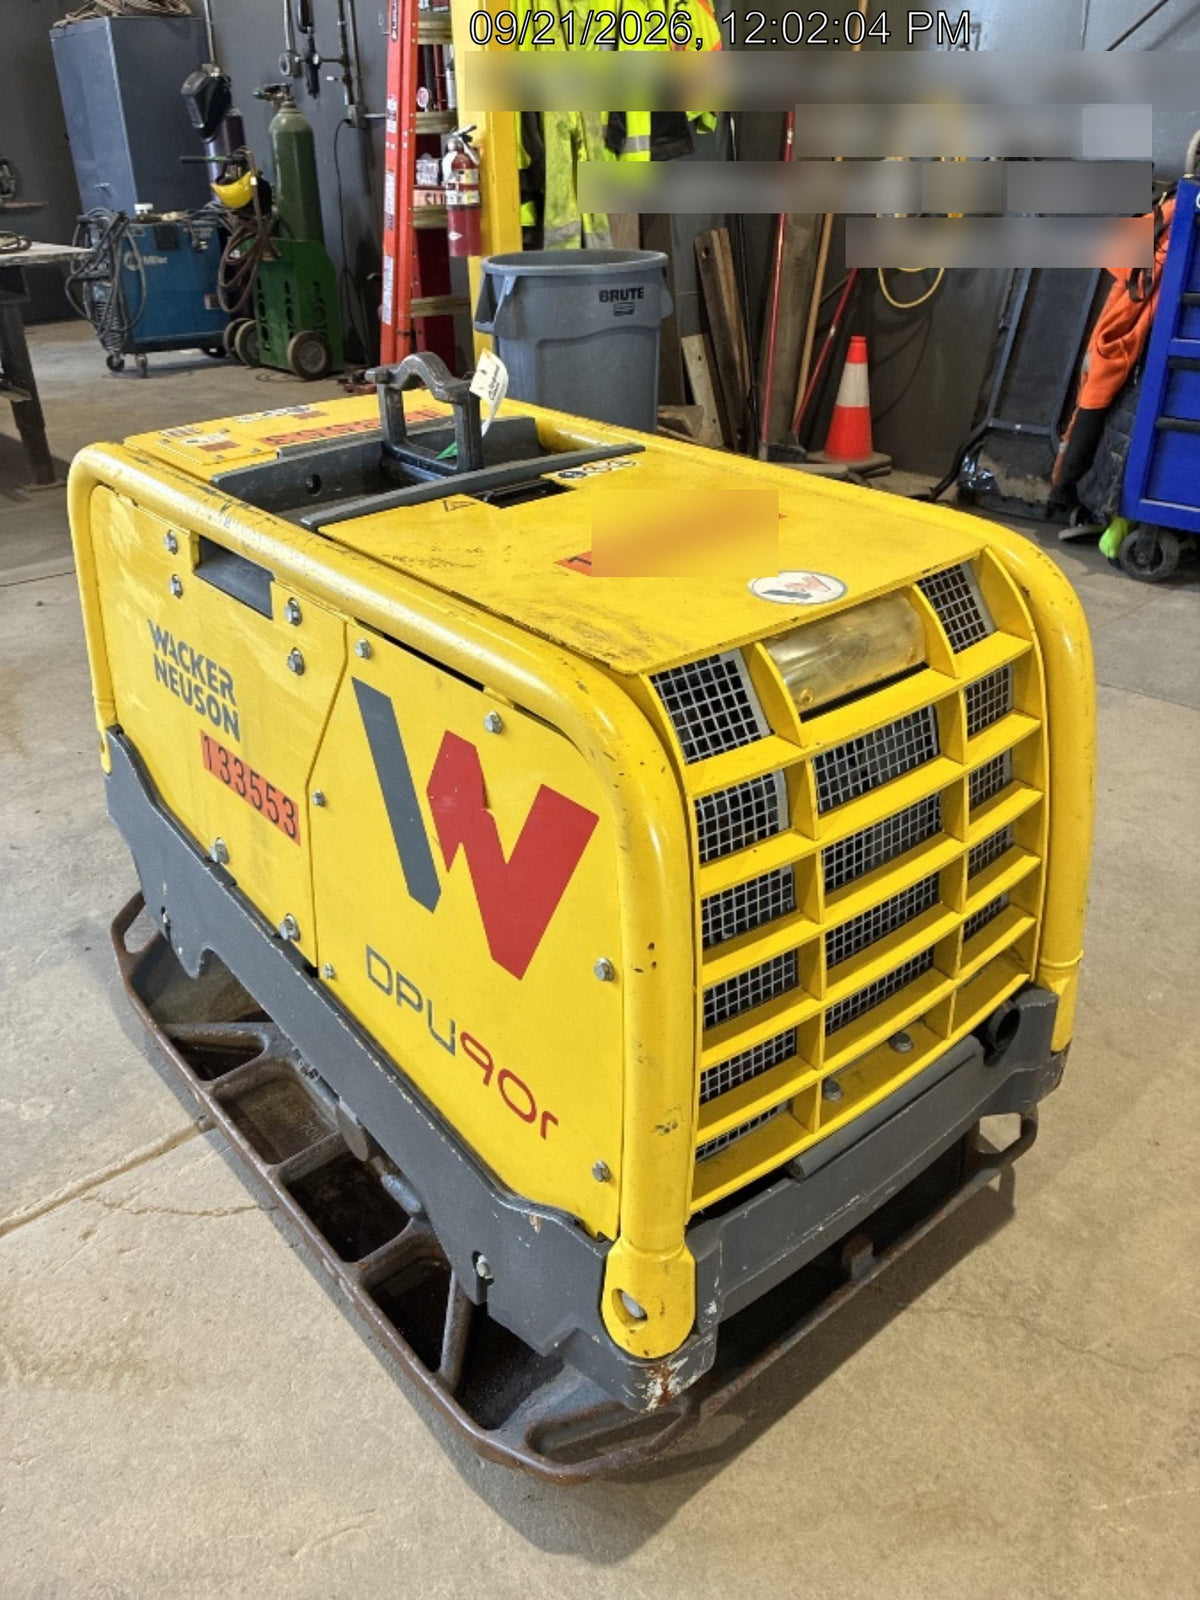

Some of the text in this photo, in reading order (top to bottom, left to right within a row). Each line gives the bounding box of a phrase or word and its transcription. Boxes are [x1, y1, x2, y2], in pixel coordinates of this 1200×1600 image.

[599, 287, 645, 303] BRUTE
[148, 618, 237, 707] WACKER
[153, 652, 241, 743] NEUSON
[203, 734, 298, 839] 133553
